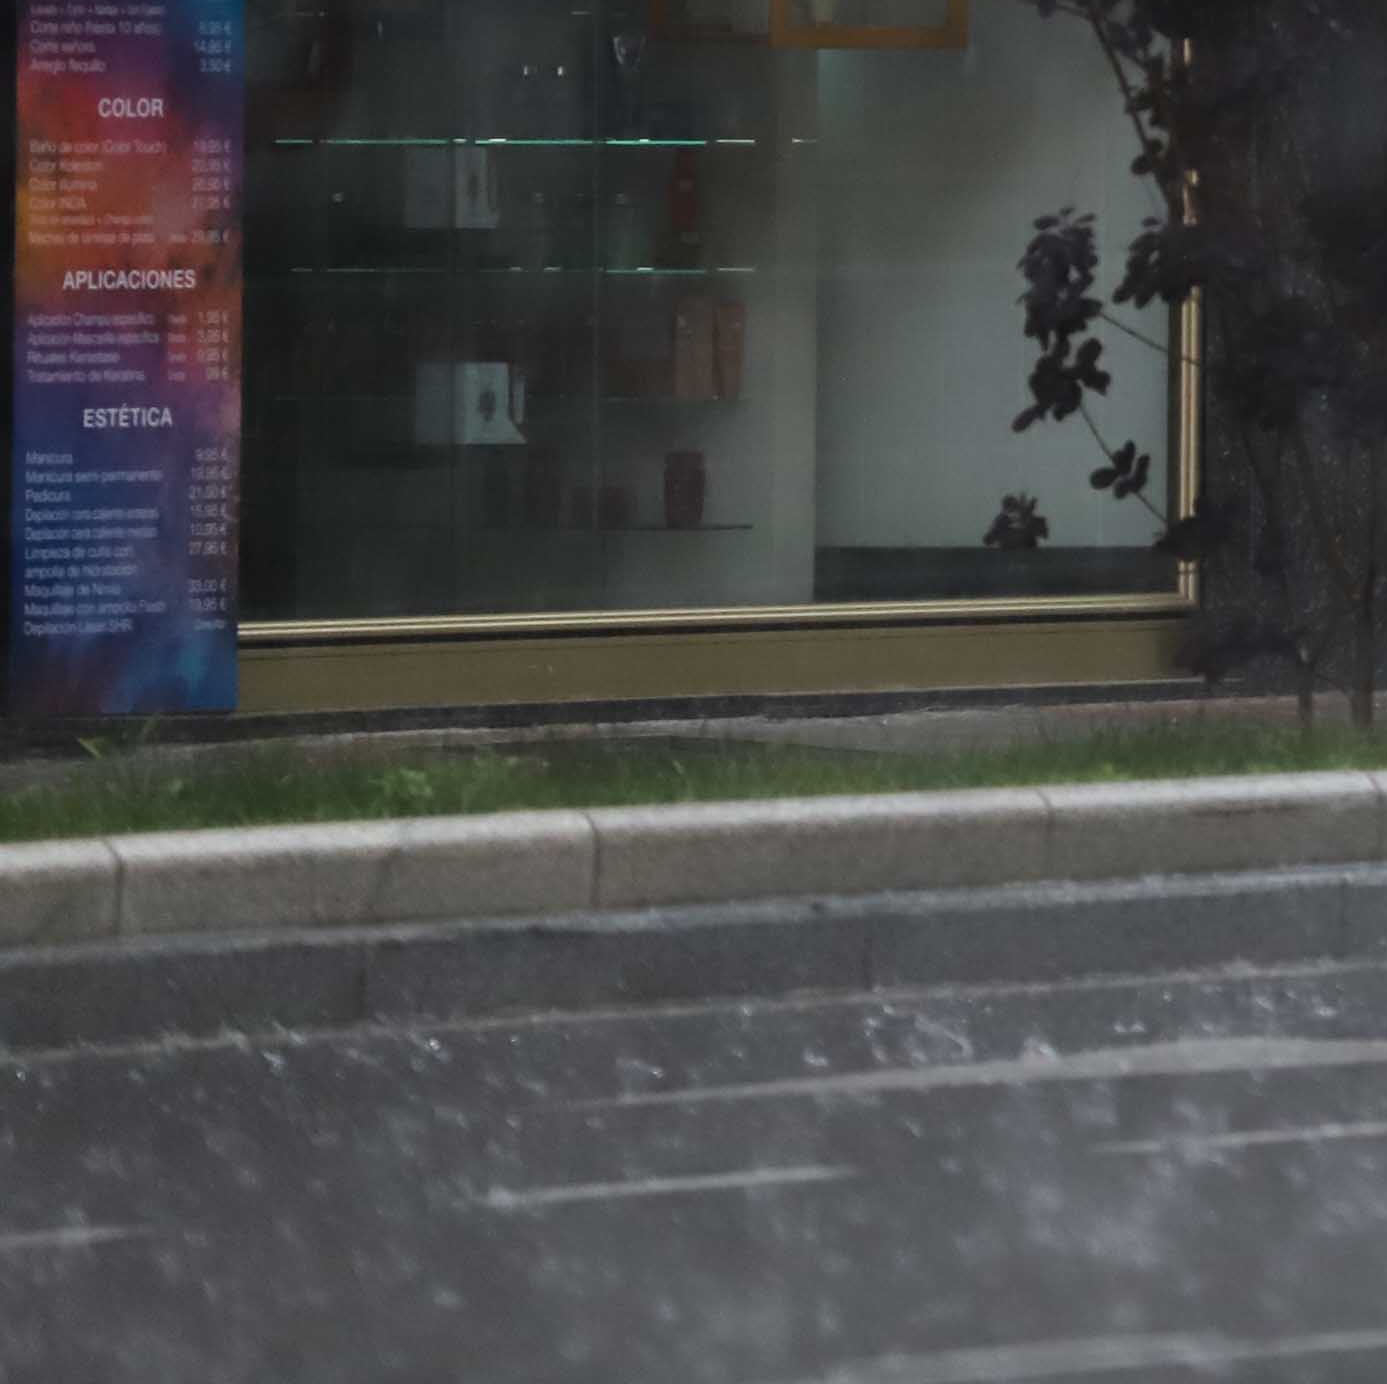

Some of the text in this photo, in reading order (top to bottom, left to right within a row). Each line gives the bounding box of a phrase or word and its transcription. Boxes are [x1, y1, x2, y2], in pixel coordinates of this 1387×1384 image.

[97, 97, 164, 118] COLOR
[62, 269, 197, 291] APLICACIONES
[82, 403, 173, 429] ESTÉTICA
